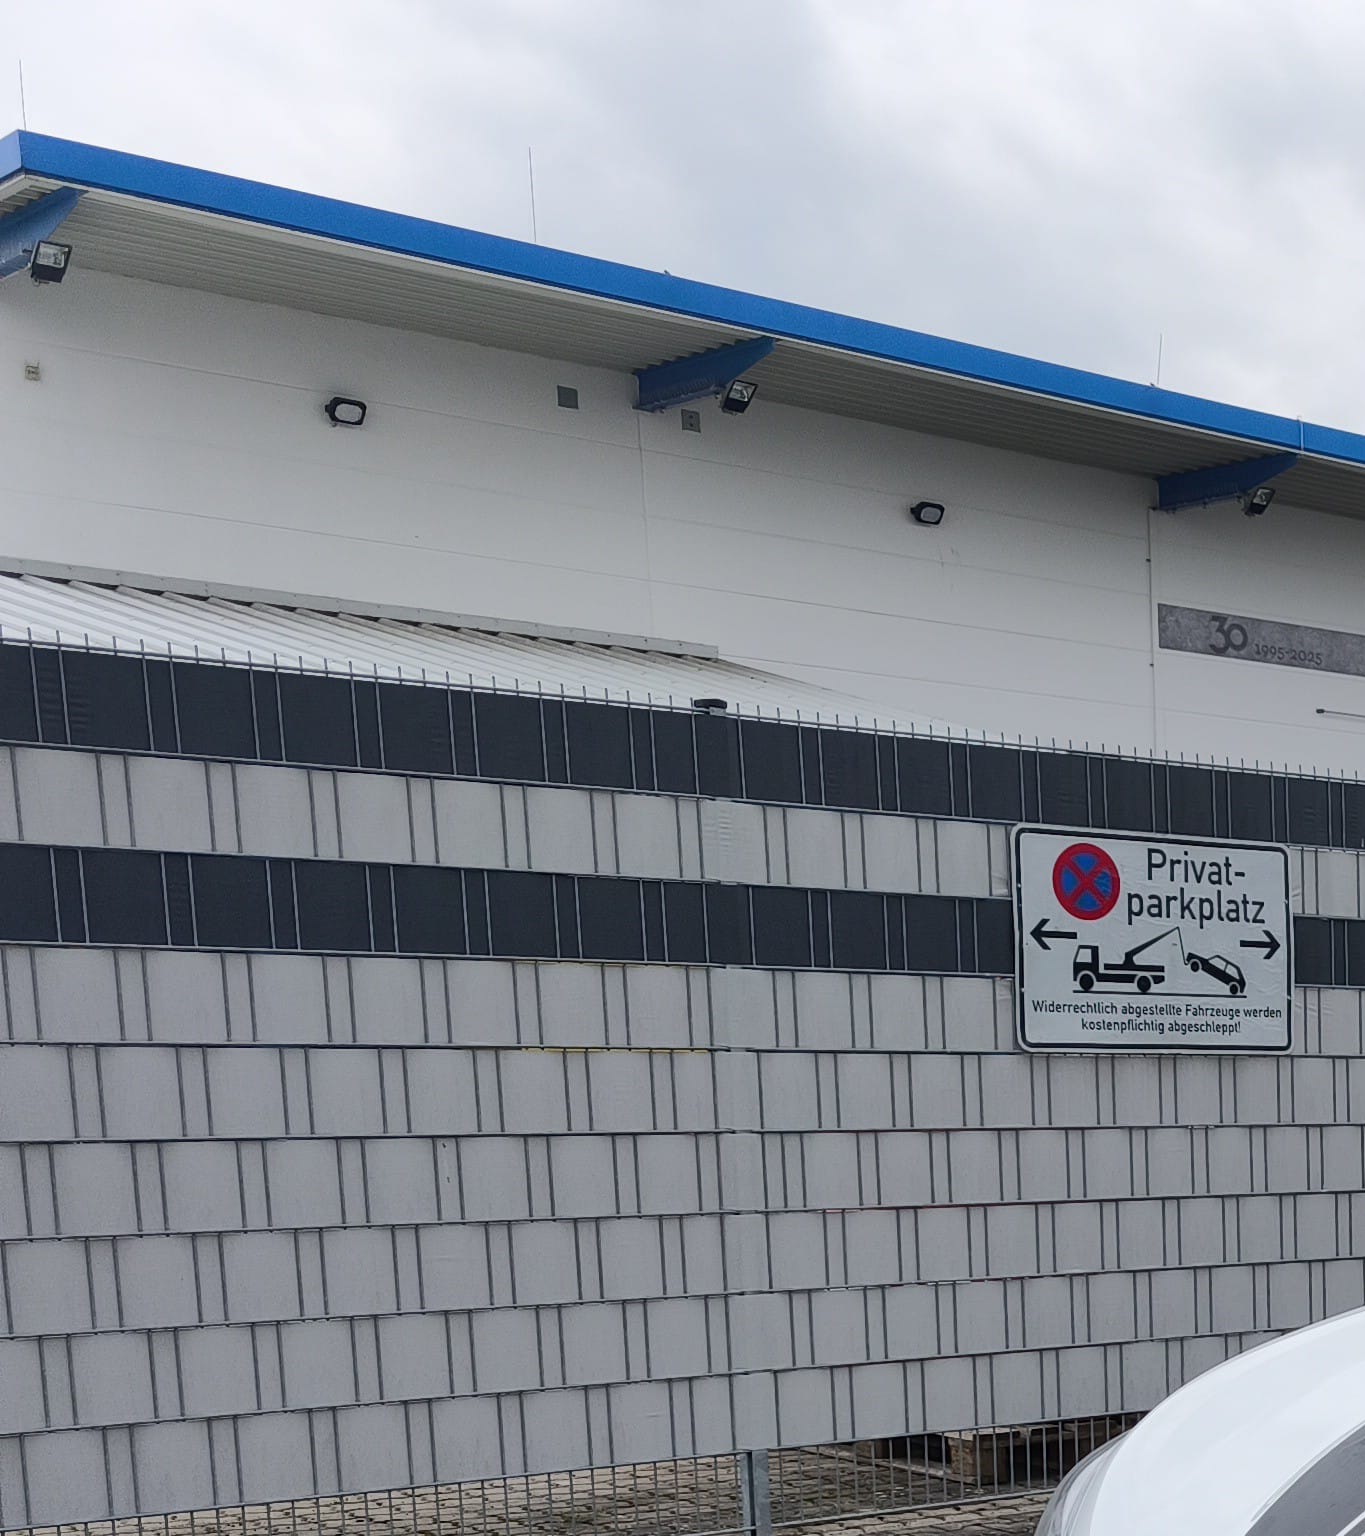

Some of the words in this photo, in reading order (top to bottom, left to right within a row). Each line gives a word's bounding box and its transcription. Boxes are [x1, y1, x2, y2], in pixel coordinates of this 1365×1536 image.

[1208, 615, 1249, 653] 30
[1254, 642, 1323, 666] 1995-2025
[1147, 847, 1246, 886] Privat-
[1127, 887, 1266, 930] parkplatz
[1032, 1000, 1118, 1015] Widerrechtlich
[1121, 1003, 1182, 1018] abgestellte
[1185, 1004, 1241, 1018] Fahrzeuge
[1243, 1006, 1282, 1018] werden
[1081, 1018, 1165, 1035] kostenpflichtig
[1167, 1020, 1241, 1036] abgeschleppt!
